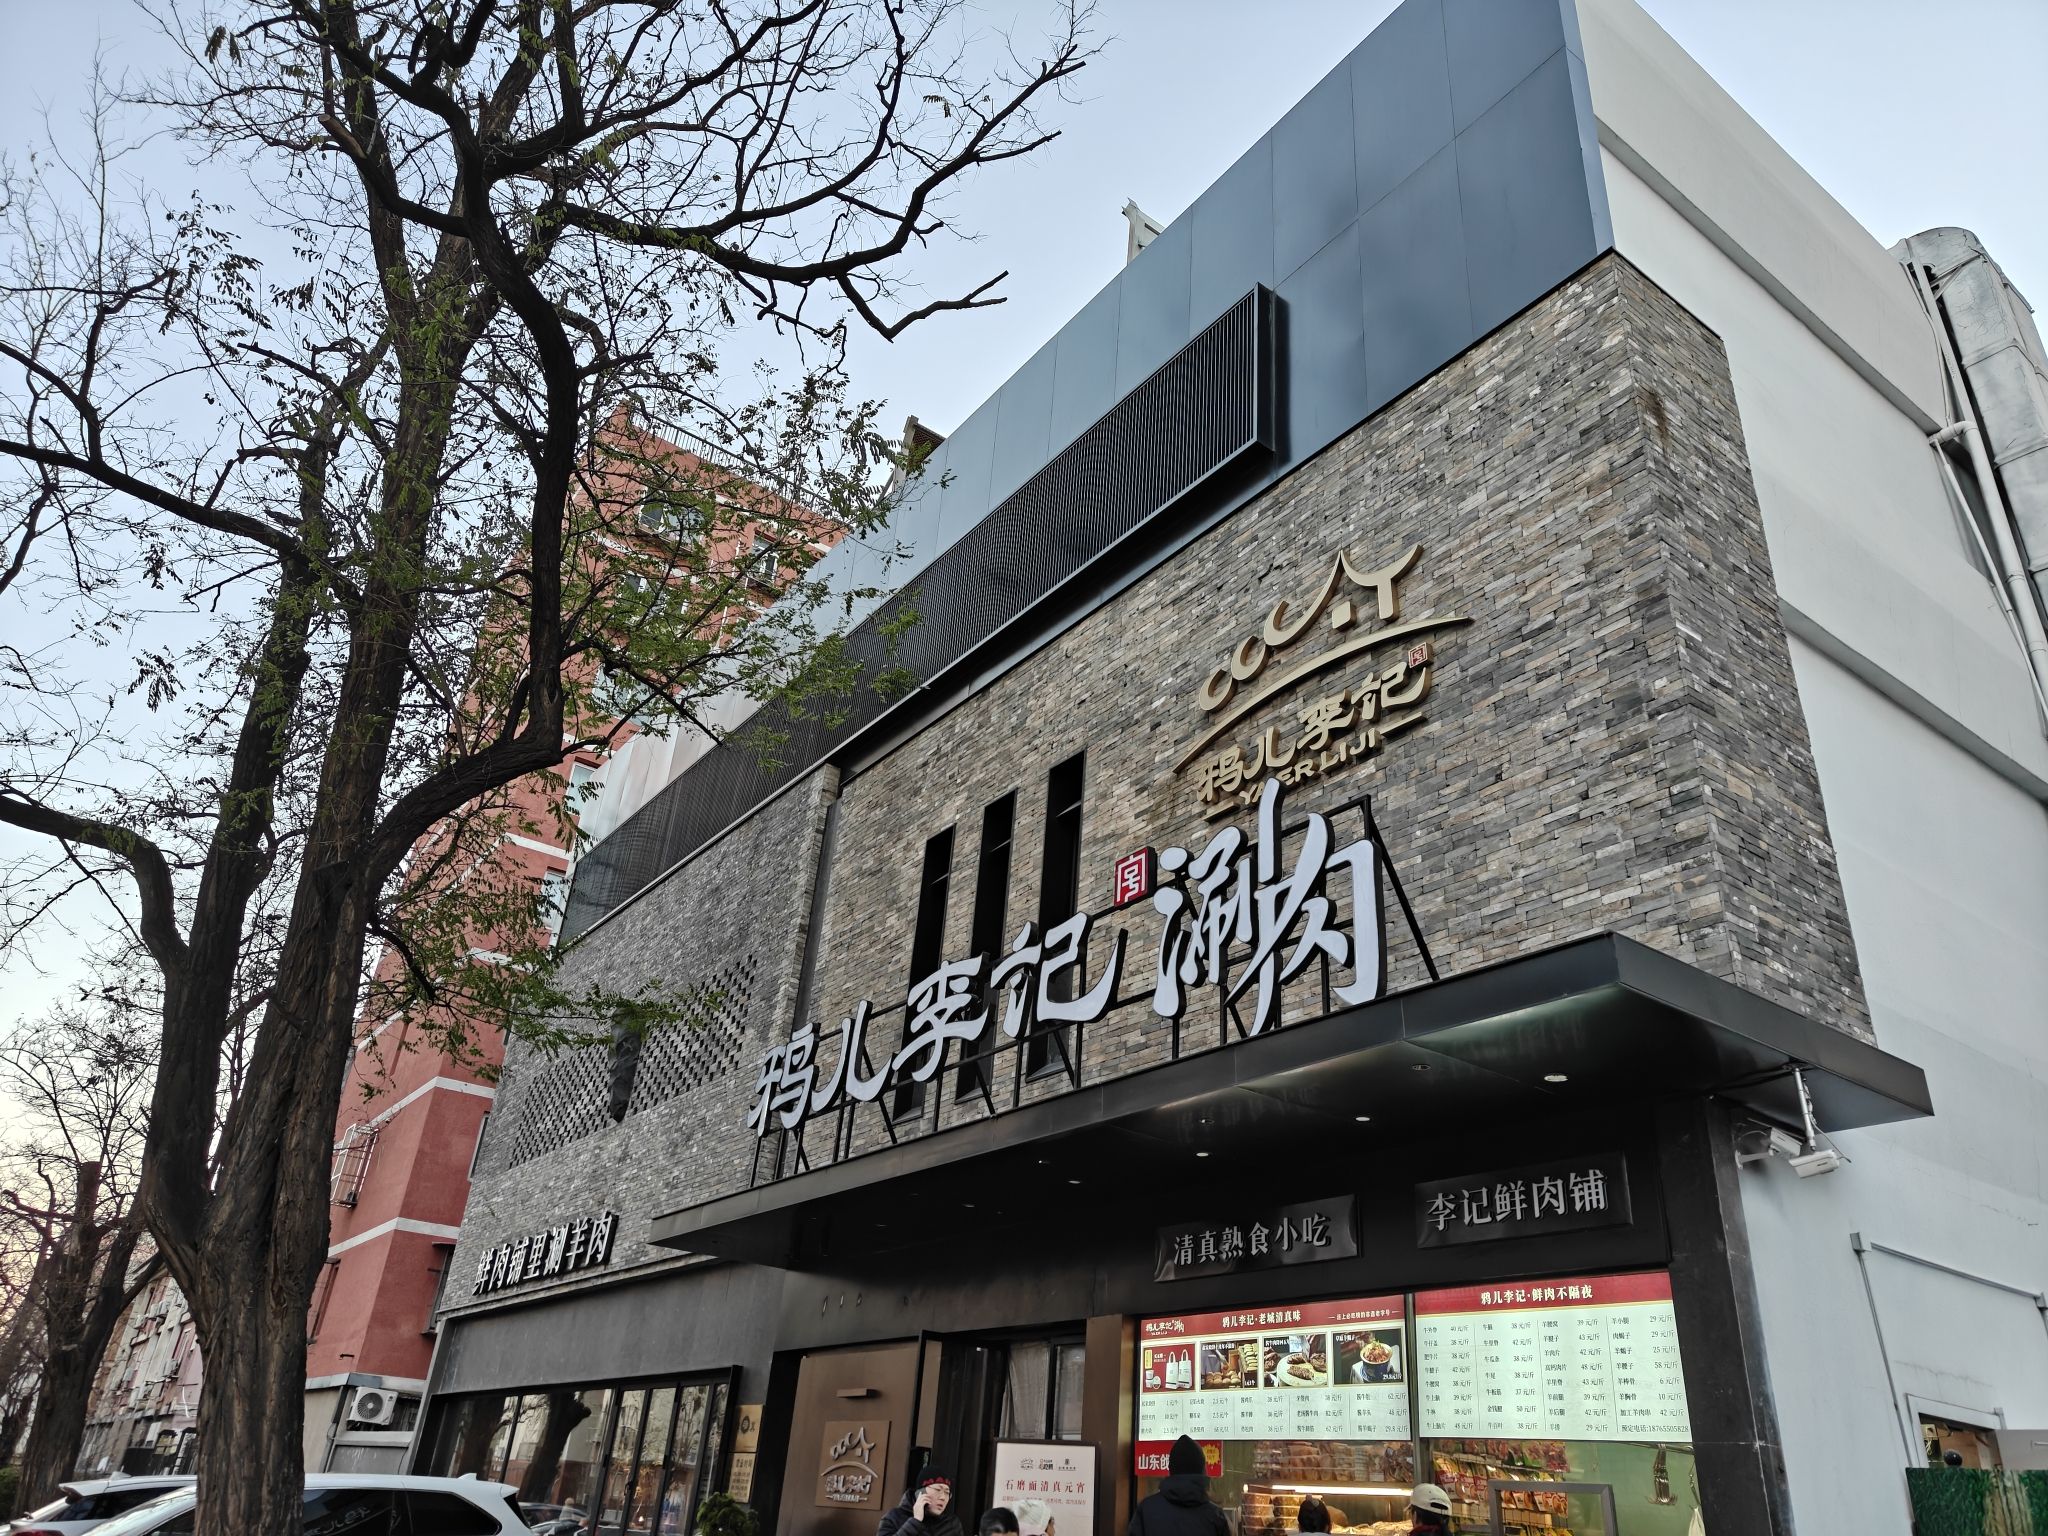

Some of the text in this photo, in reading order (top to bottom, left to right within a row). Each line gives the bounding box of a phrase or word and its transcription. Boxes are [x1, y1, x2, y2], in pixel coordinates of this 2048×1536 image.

[1196, 661, 1428, 802] 鸦儿李记
[1425, 1168, 1608, 1232] 李记鲜肉铺
[473, 1210, 614, 1294] 鲜肉铺里涮羊肉
[1173, 1211, 1330, 1267] 清真熟食小吃
[1480, 1284, 1594, 1306] 鸦儿李记·鲜肉不隔夜
[1005, 1479, 1085, 1494] 石磨面清真元宵
